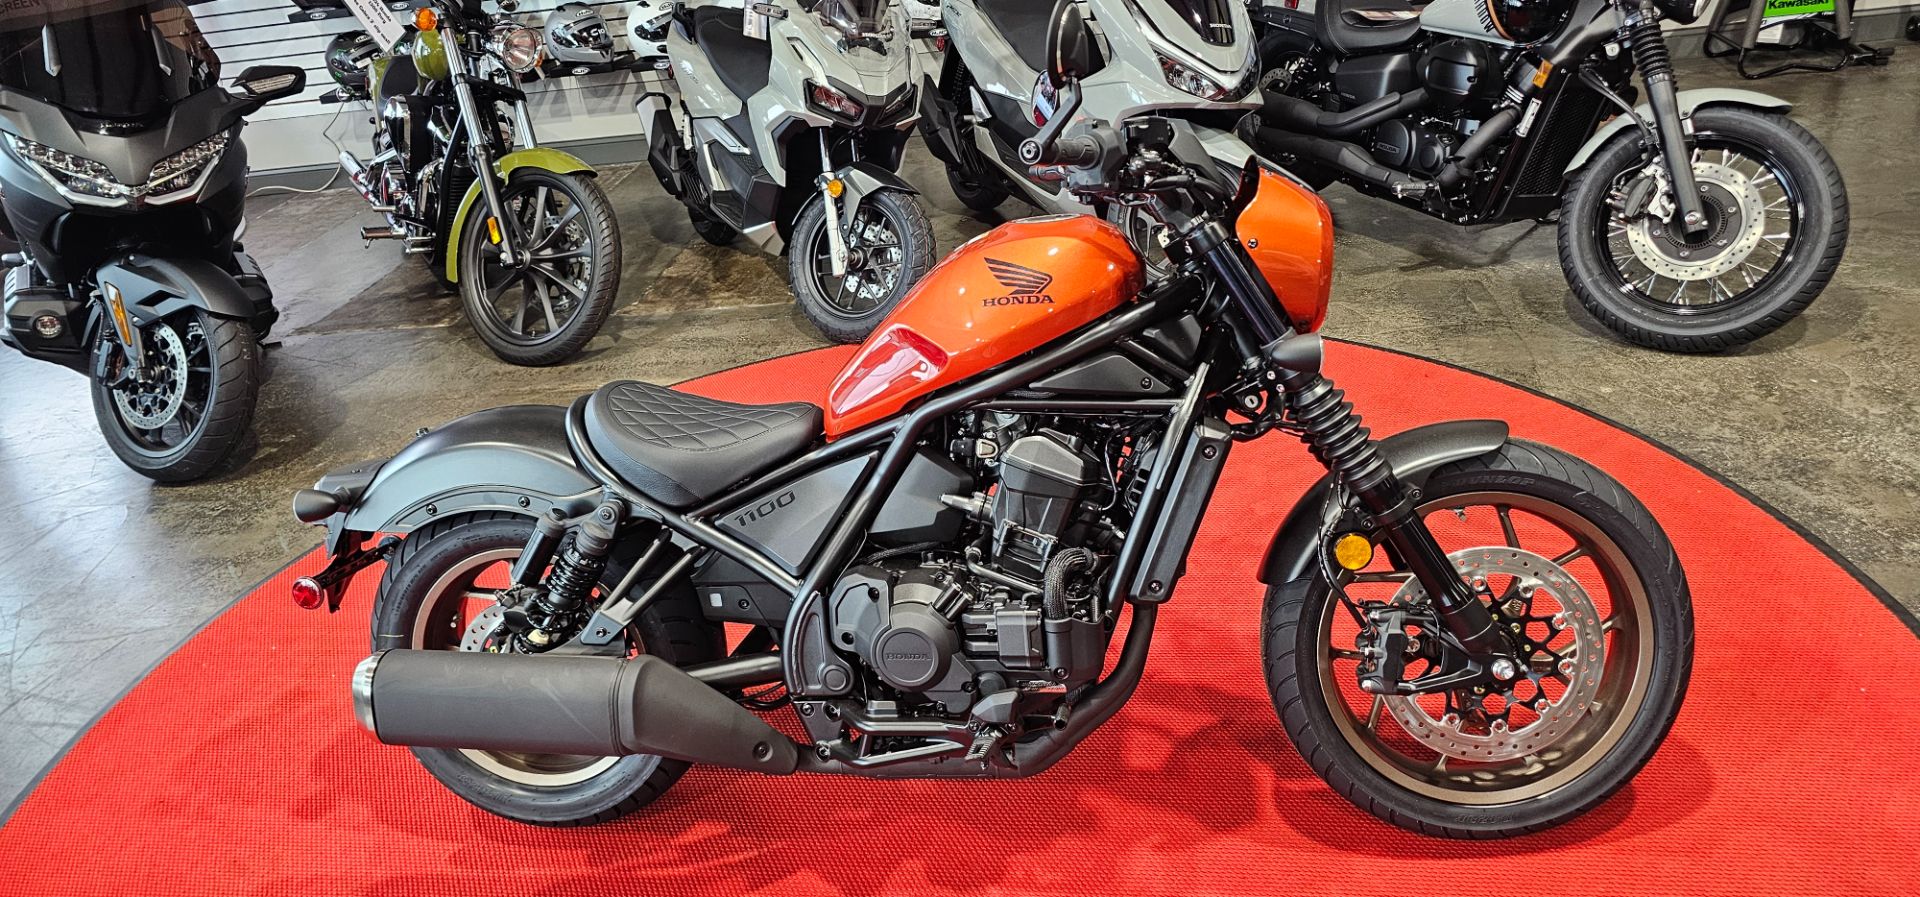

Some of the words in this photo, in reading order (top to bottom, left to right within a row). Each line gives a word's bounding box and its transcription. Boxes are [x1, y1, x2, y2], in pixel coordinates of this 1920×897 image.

[983, 295, 1054, 307] HONDA
[734, 489, 796, 527] 1100
[886, 652, 933, 661] HONDA
